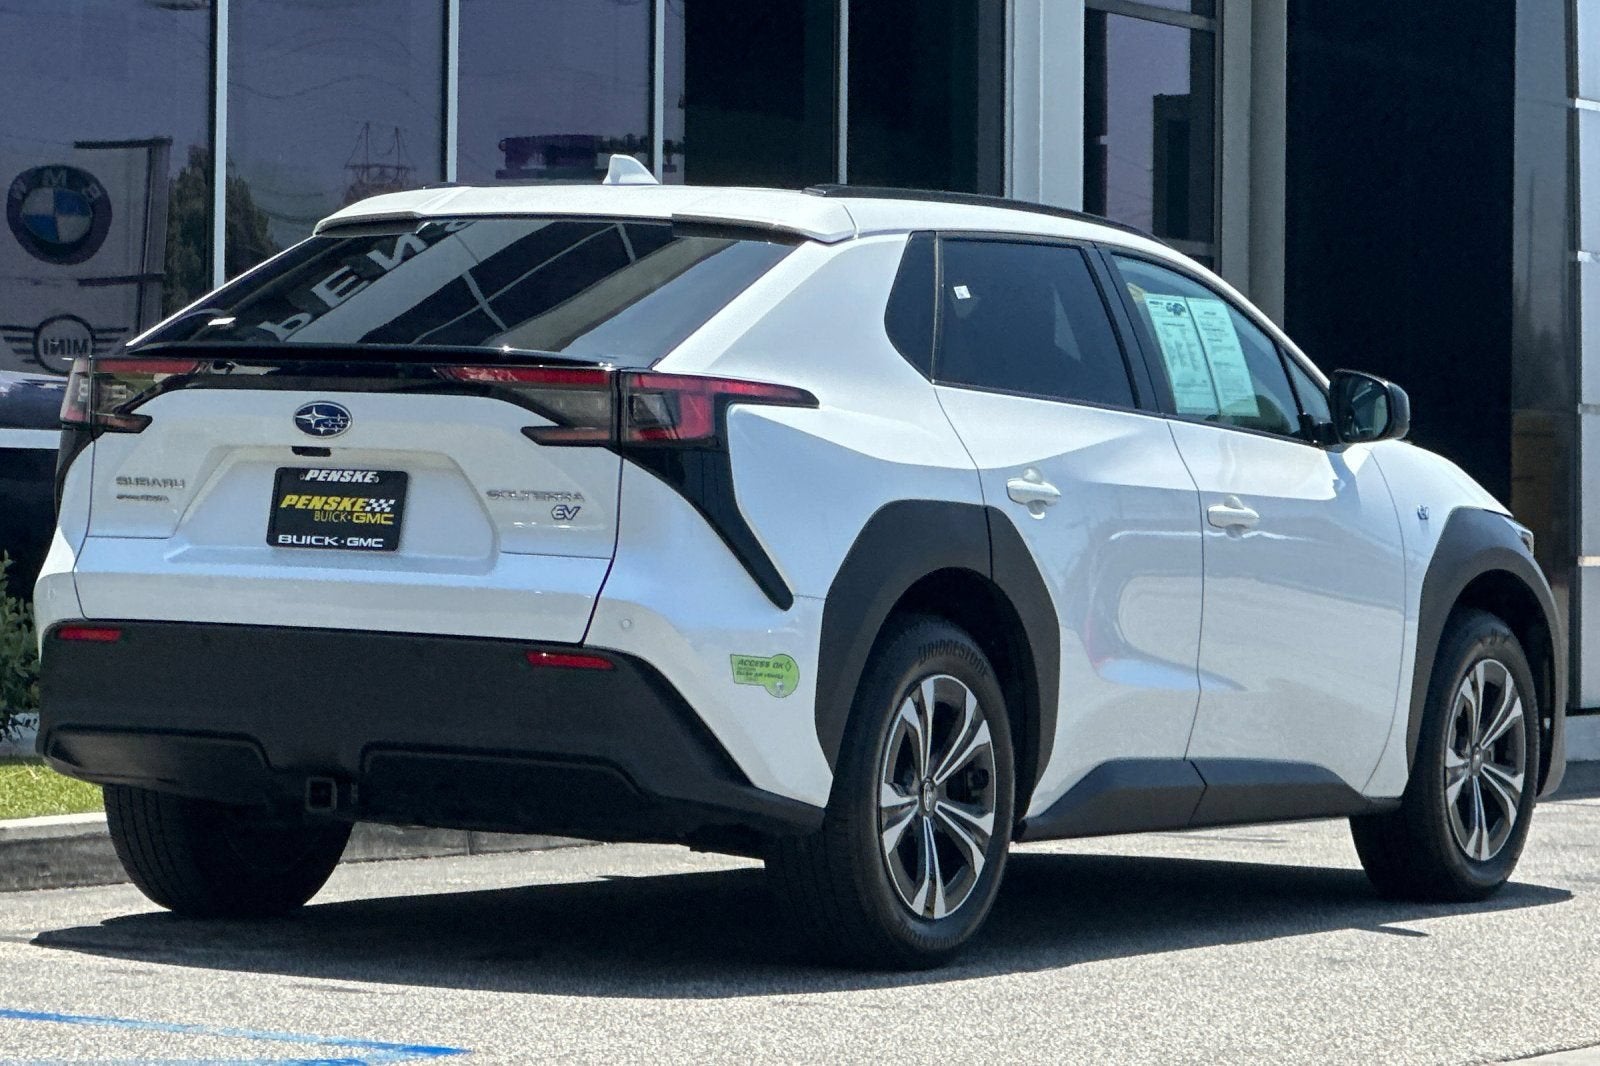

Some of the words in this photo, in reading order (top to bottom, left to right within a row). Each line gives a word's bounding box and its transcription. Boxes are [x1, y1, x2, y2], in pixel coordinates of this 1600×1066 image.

[305, 470, 377, 483] PENSKE
[280, 494, 367, 512] PENSKE
[314, 511, 348, 523] BUICK
[352, 513, 395, 525] GMC
[551, 504, 581, 520] EV
[278, 534, 338, 546] BUICK
[346, 537, 384, 548] GMC
[738, 659, 770, 668] ACCESS
[773, 661, 784, 669] OK
